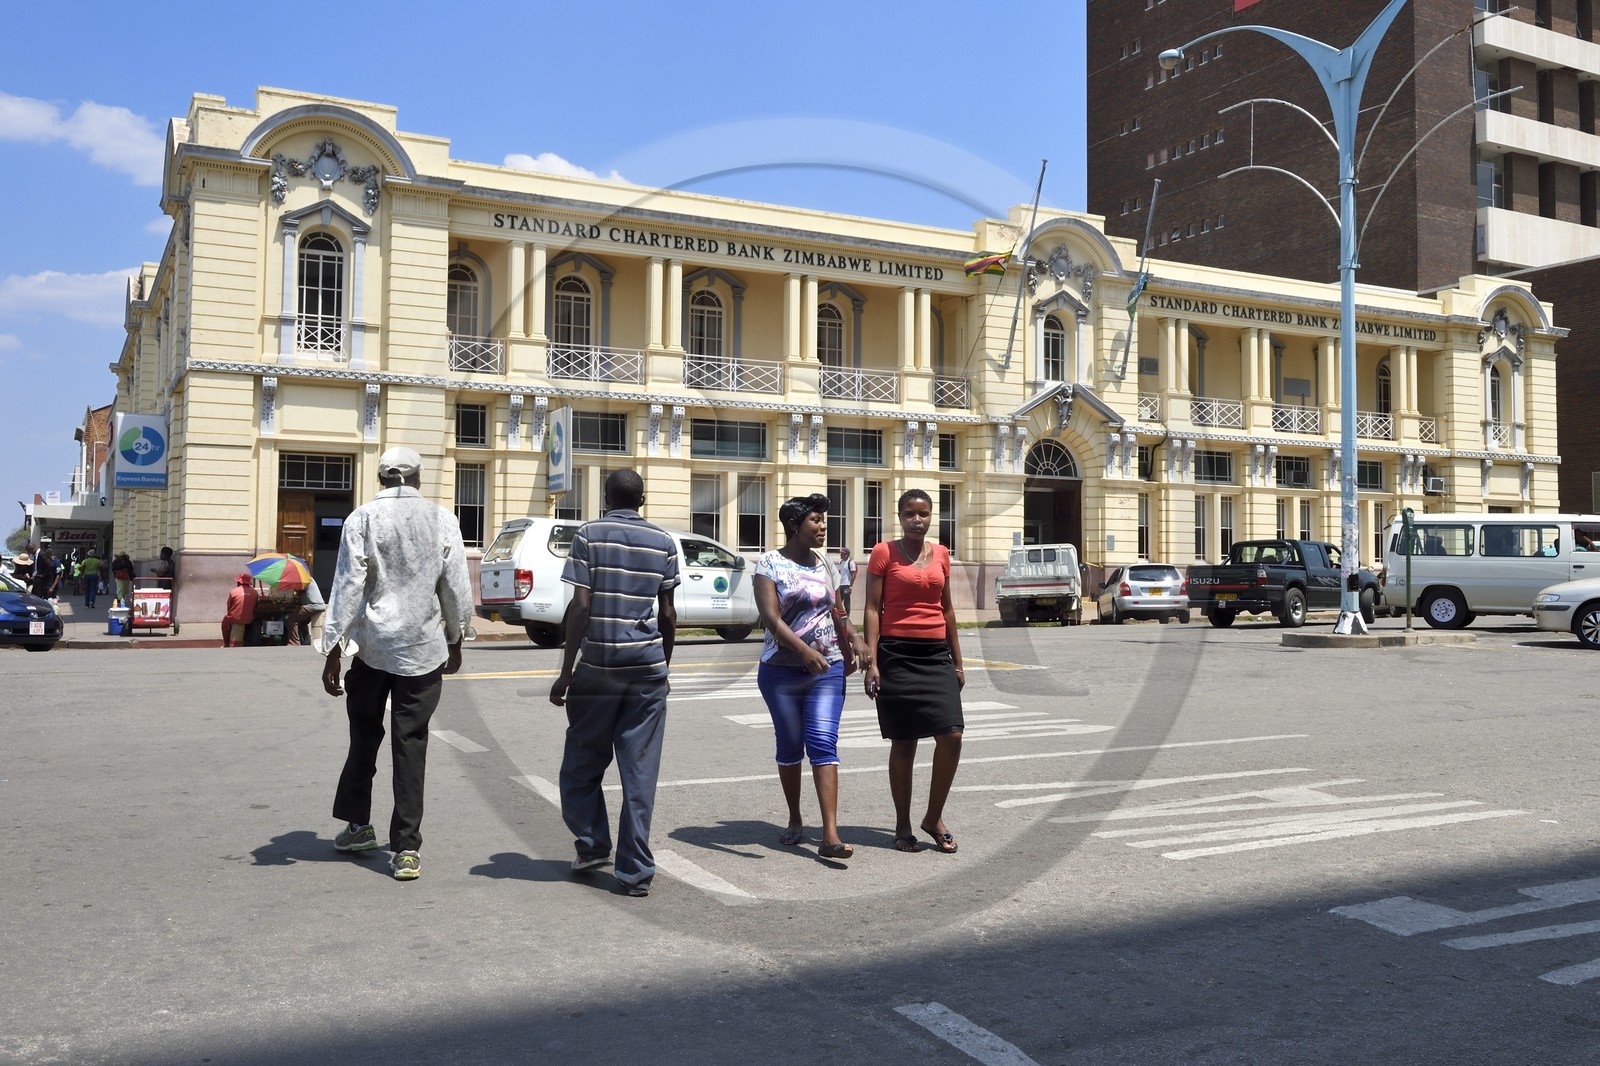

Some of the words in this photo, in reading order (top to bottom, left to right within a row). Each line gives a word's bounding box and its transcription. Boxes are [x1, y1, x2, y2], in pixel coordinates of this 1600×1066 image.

[493, 213, 601, 239] STANDARD
[609, 228, 719, 254] CHARTERED
[726, 242, 775, 261] BANK
[783, 249, 872, 272] ZIMBABWE
[878, 261, 944, 281] LIMITED
[1150, 295, 1218, 315] STANDARD
[1222, 304, 1293, 324] CHARTERED
[1297, 314, 1328, 329] BANK
[1332, 318, 1390, 336] ZBABWE
[1393, 326, 1437, 341] LIMITED
[141, 476, 166, 484] Banking
[56, 530, 97, 541] Bata
[1189, 577, 1220, 585] ISUZU
